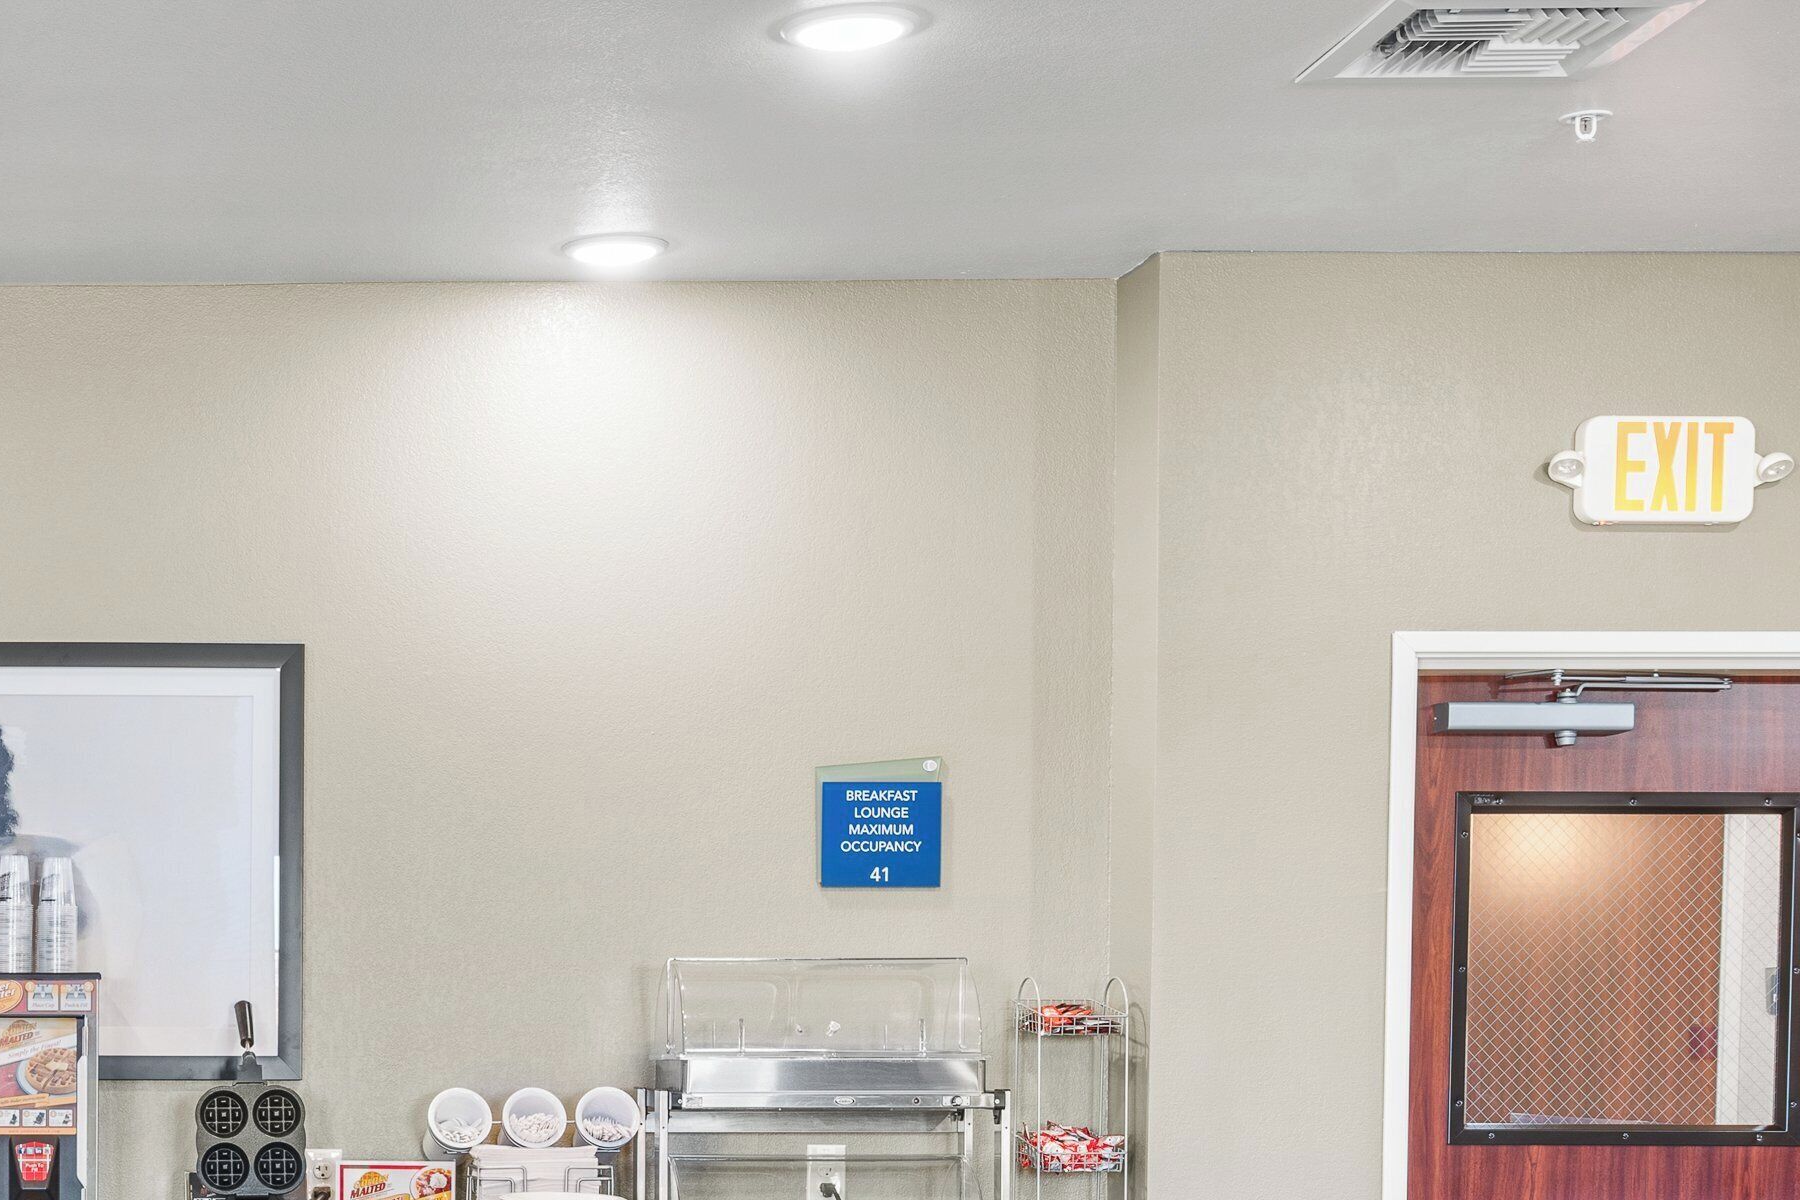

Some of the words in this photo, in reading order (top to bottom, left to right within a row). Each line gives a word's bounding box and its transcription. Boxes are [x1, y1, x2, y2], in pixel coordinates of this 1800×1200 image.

[1614, 421, 1735, 512] EXIT
[846, 789, 918, 802] BREAKFAST
[854, 807, 910, 819] LOUNGE
[848, 823, 914, 836] MAXIMUM
[840, 840, 922, 853] OCCUPANCY
[869, 866, 890, 882] 41
[350, 1182, 386, 1199] MALTED
